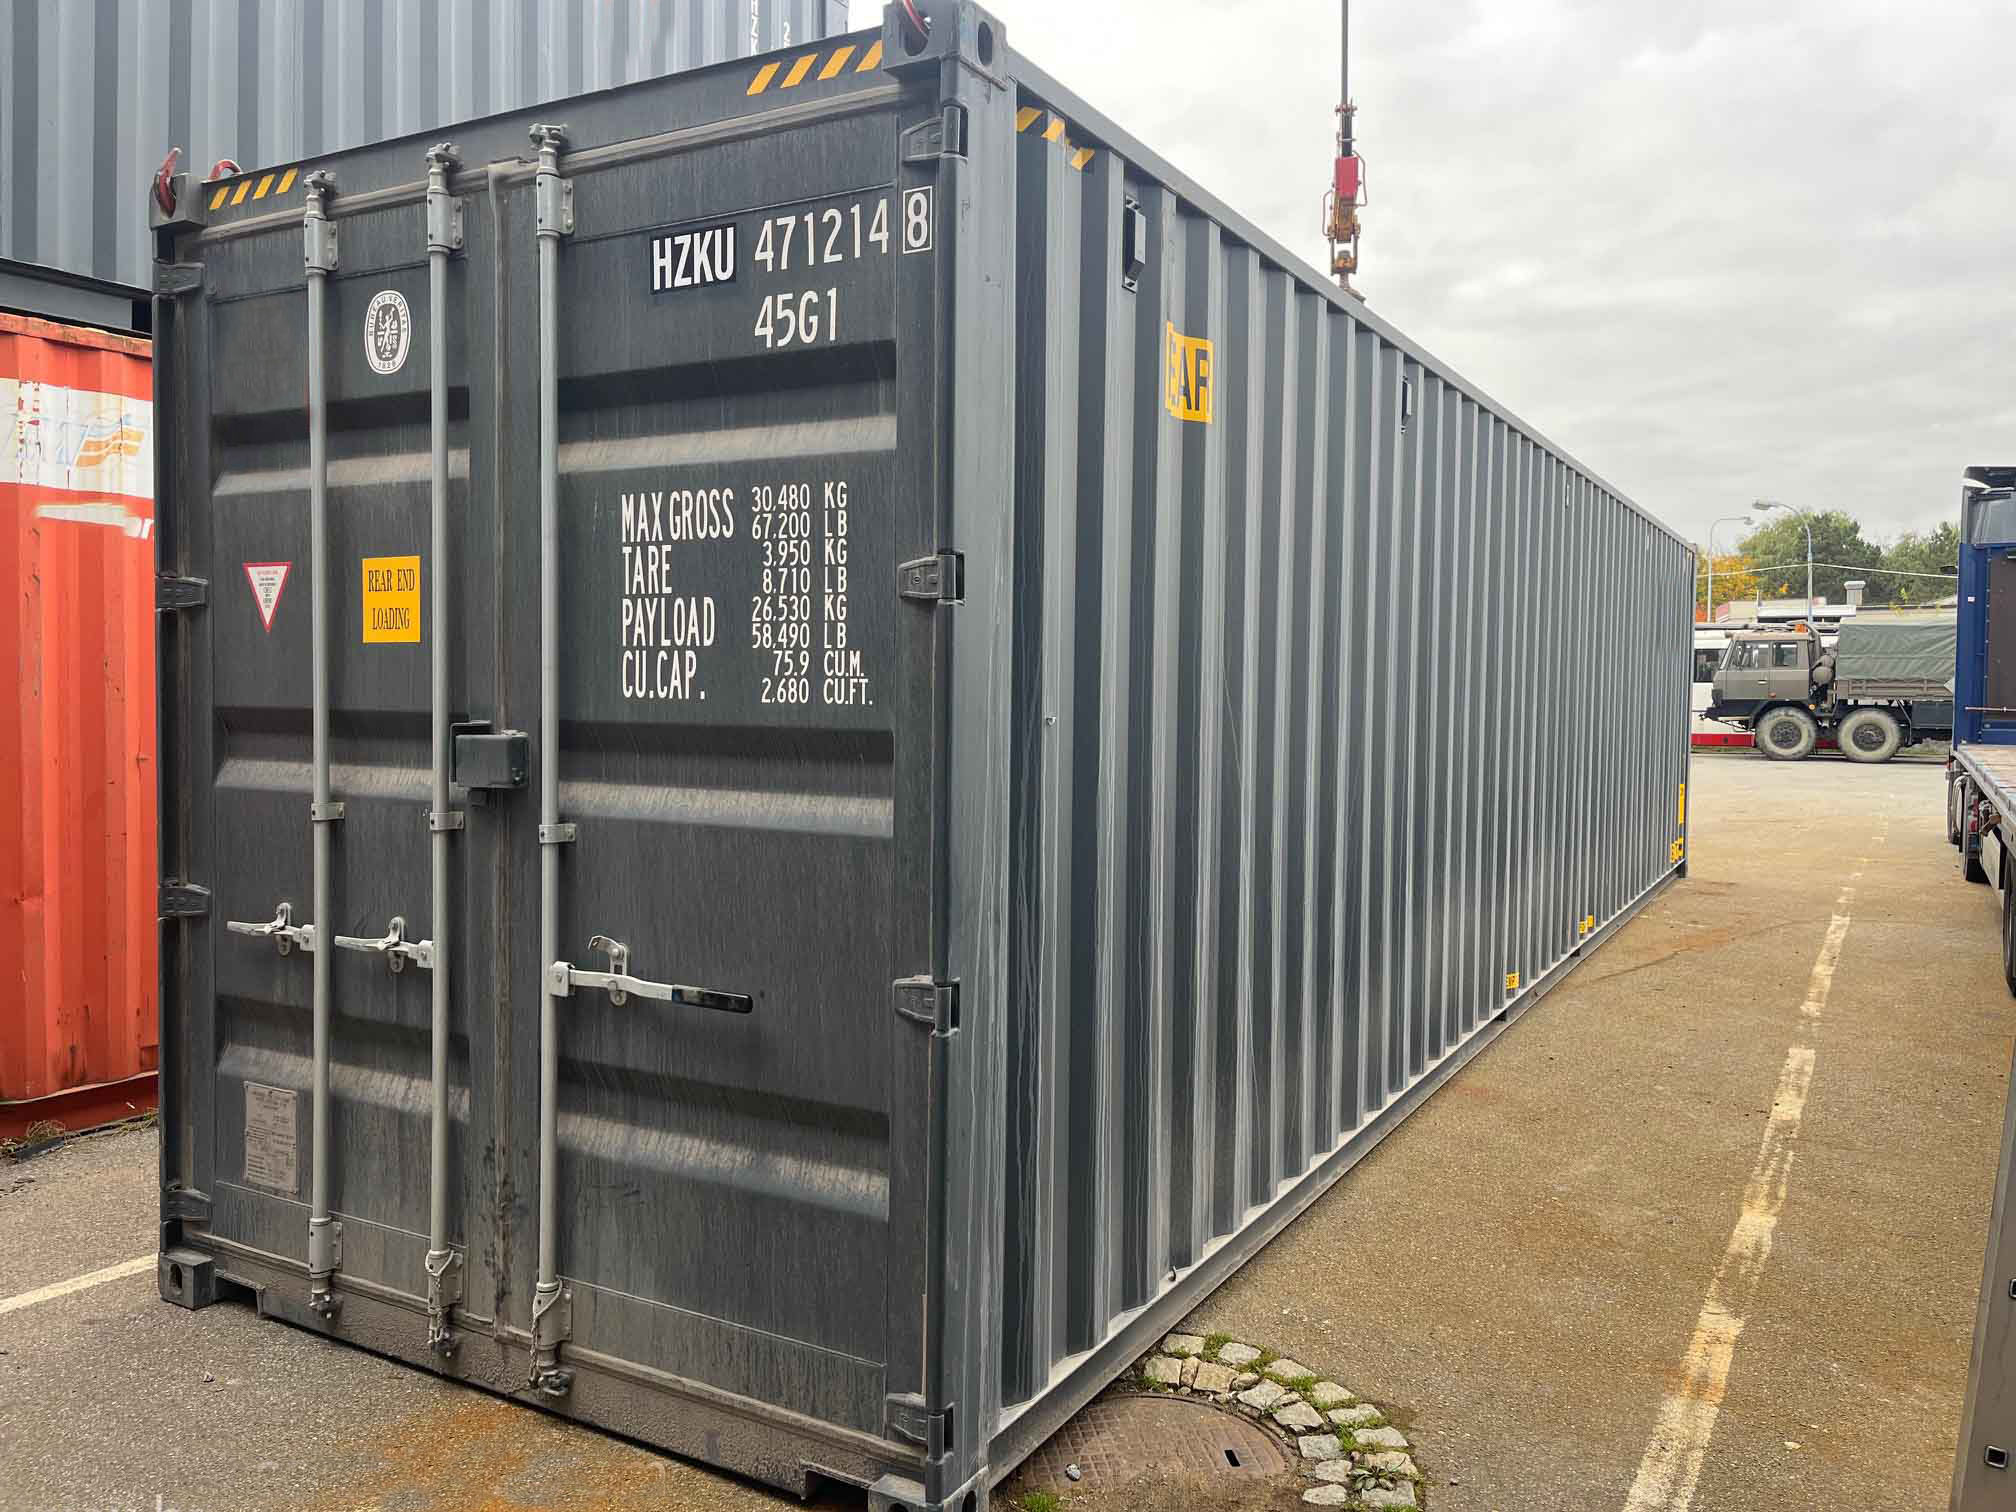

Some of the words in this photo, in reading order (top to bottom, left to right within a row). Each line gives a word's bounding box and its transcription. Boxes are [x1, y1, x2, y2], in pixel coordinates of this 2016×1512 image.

[653, 226, 734, 290] HZKU
[754, 198, 889, 272] 471214
[906, 191, 928, 248] 8
[754, 287, 837, 349] 45G1
[751, 483, 810, 512] 30,480
[824, 481, 848, 509] KG
[621, 492, 663, 543] MAX
[669, 487, 734, 541] GROSS
[751, 511, 811, 540] 67,200
[824, 510, 848, 537] LB
[762, 539, 811, 567] 3,950
[824, 538, 848, 565] KG
[368, 569, 393, 592] REAR
[397, 568, 415, 592] END
[622, 544, 673, 595] TARE
[762, 567, 811, 595] 8,710
[824, 566, 848, 593] LB
[372, 607, 410, 630] LOADING
[622, 596, 715, 647] PAYLOAD
[751, 595, 810, 622] 26,530
[824, 594, 848, 621] KG
[751, 622, 810, 649] 58,490
[824, 622, 848, 649] LB
[622, 650, 706, 700] CU.CAP.
[773, 650, 810, 676] 75.9
[823, 650, 865, 677] CU.M.
[761, 677, 810, 704] 2,680
[823, 678, 873, 705] CU.FT.
